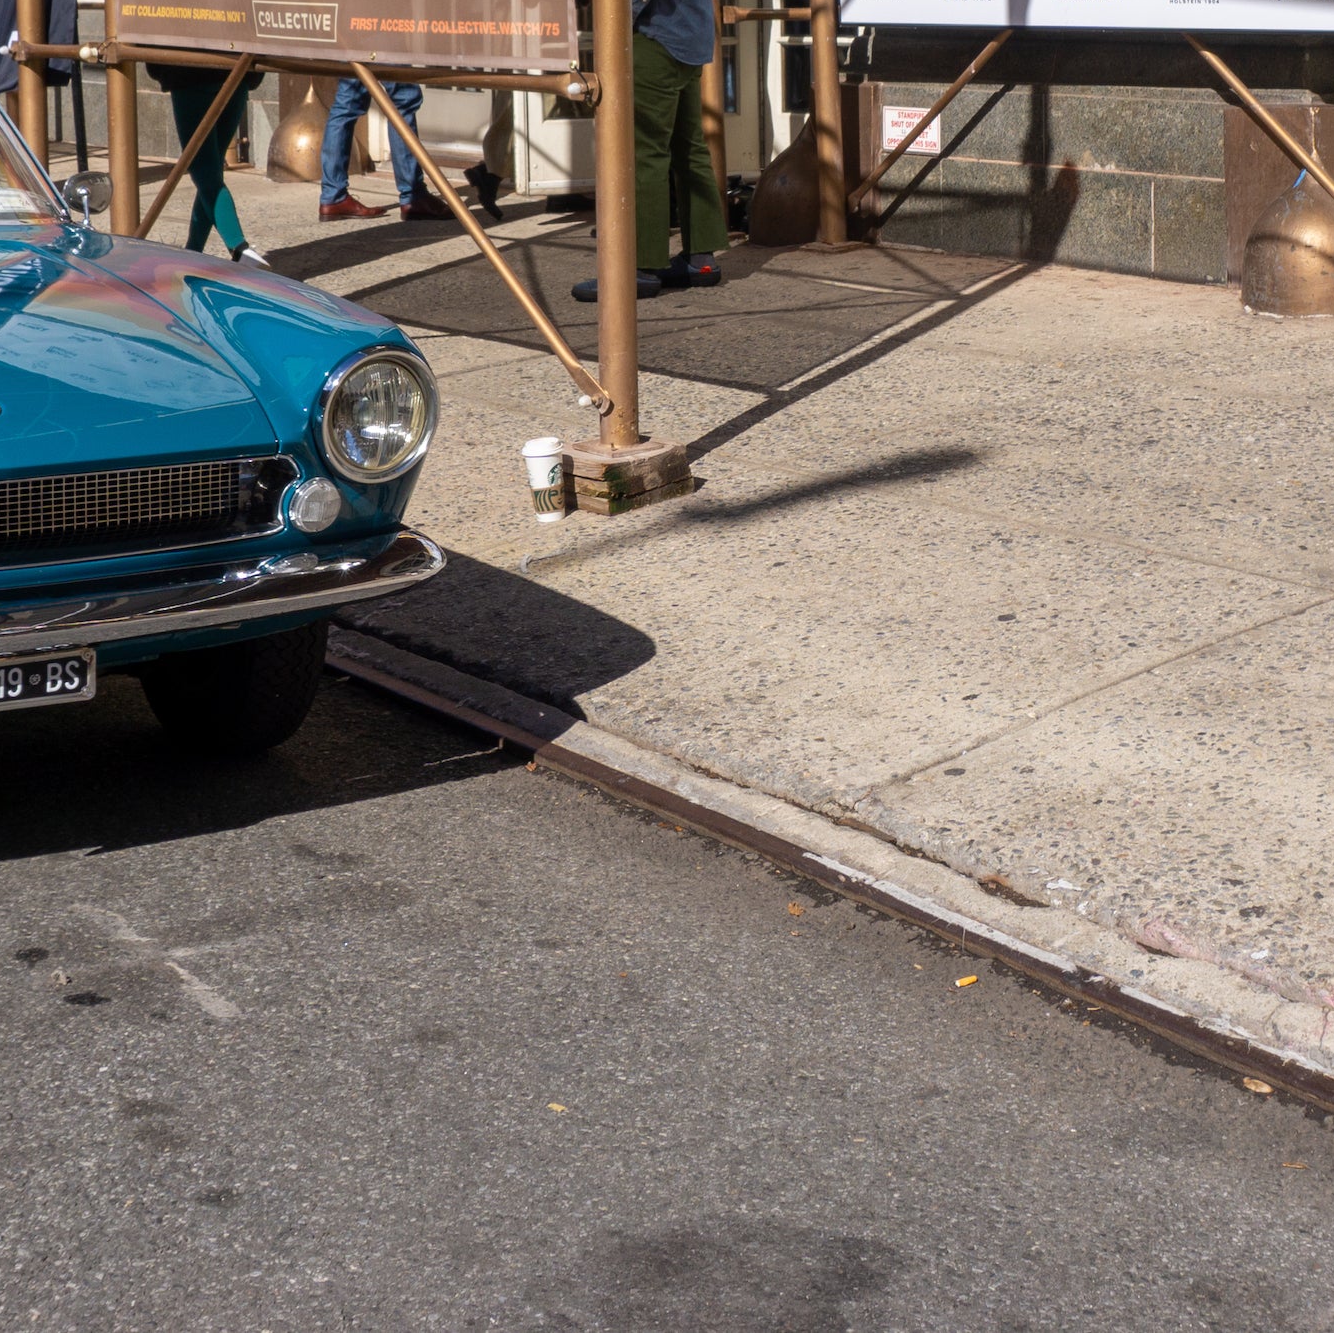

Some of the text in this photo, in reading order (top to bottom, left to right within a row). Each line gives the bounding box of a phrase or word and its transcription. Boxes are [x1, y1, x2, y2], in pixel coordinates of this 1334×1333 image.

[121, 4, 137, 17] NEXT
[137, 5, 192, 19] COLLABORATION
[350, 17, 561, 37] FIRST ACCESS AT COLLECTIVE.WATCH/75
[45, 660, 81, 694] BS
